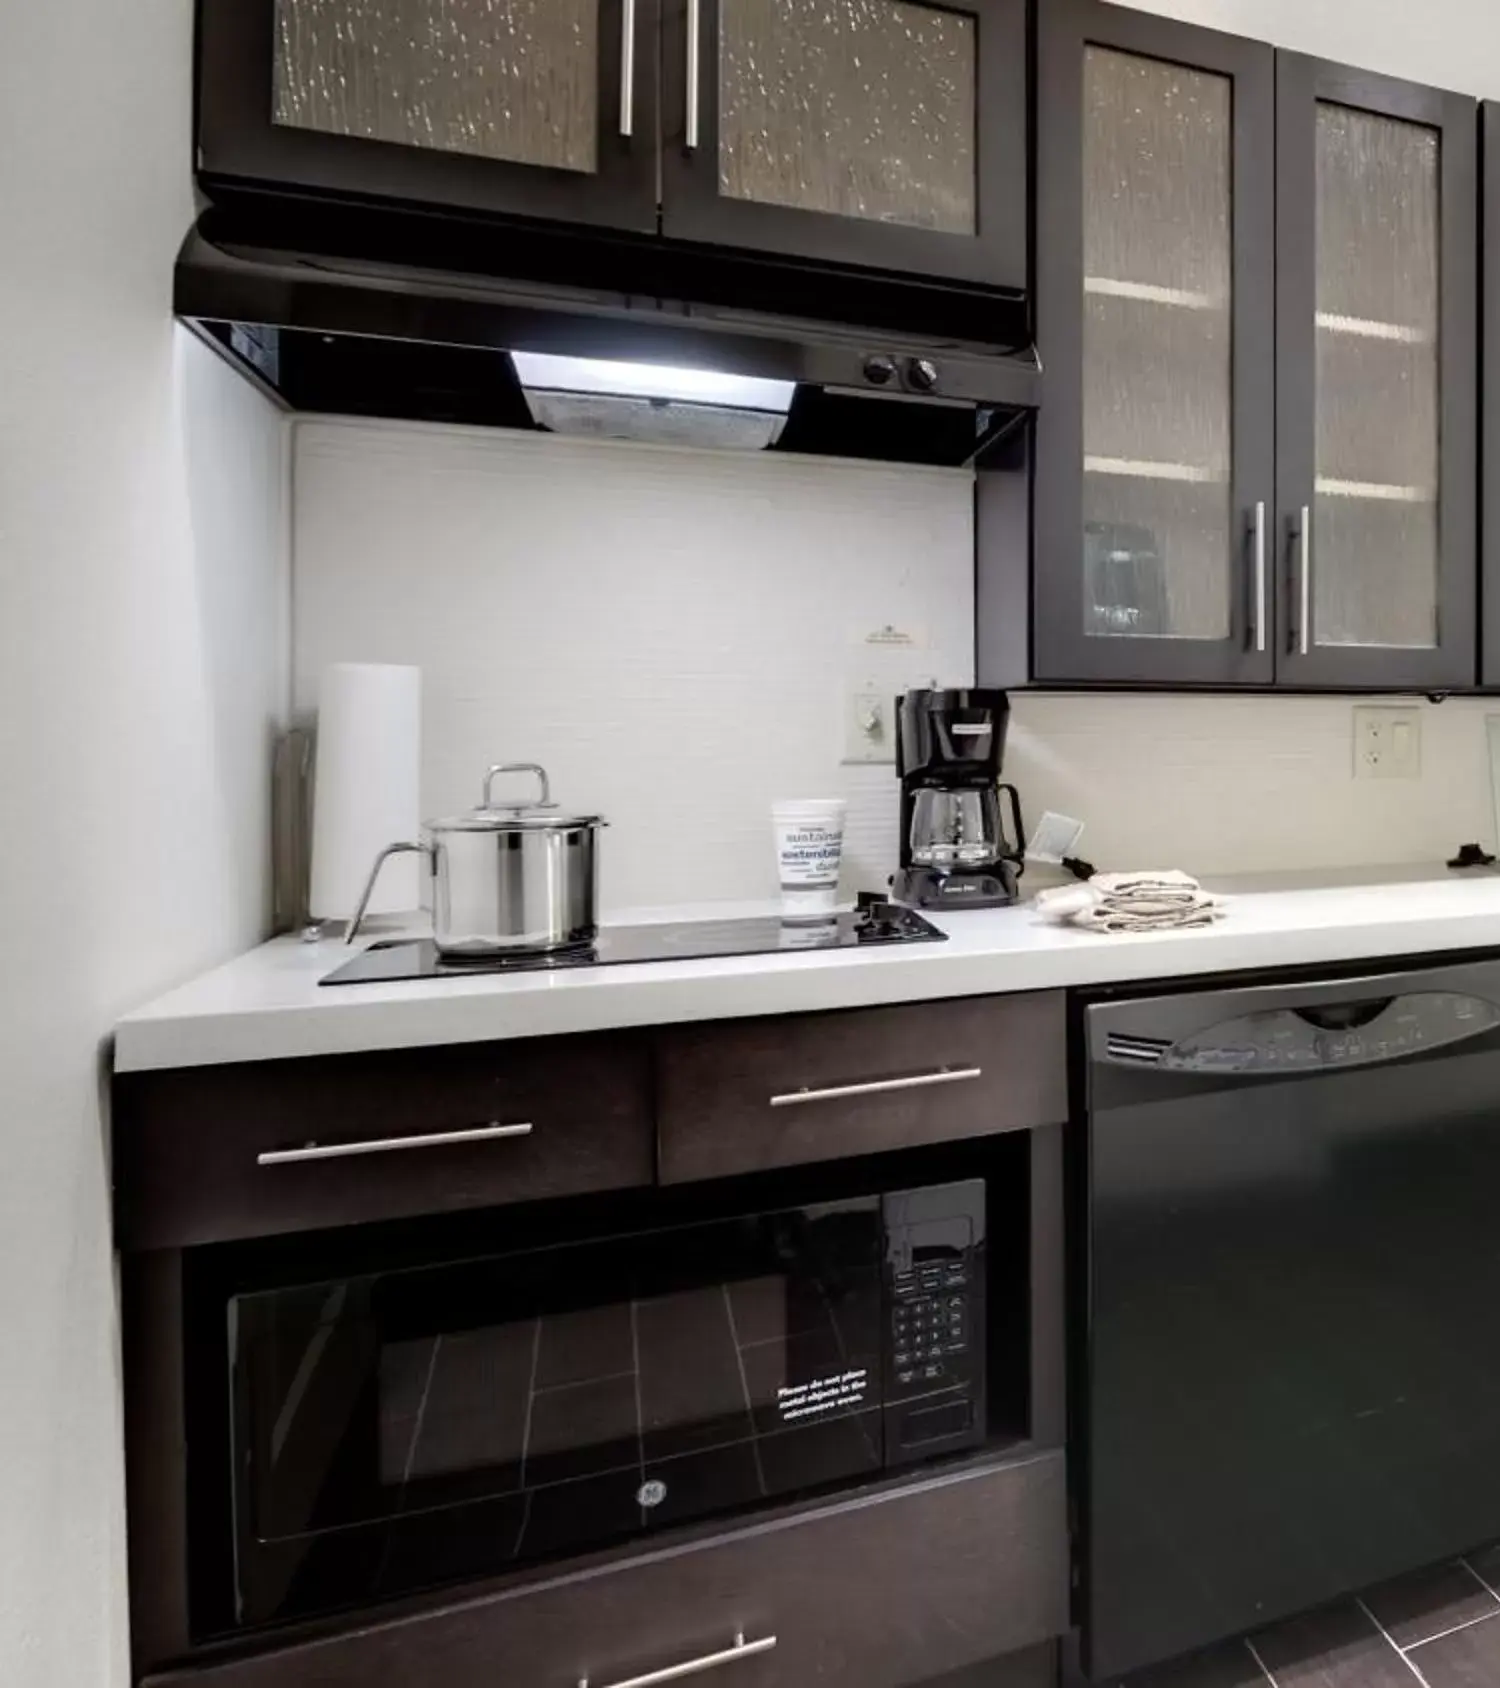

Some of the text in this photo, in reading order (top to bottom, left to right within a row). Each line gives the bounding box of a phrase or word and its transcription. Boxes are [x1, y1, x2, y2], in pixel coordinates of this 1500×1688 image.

[778, 1369, 867, 1398] Please do not place
[779, 1380, 867, 1409] metal objects in the
[783, 1401, 836, 1420] microwave
